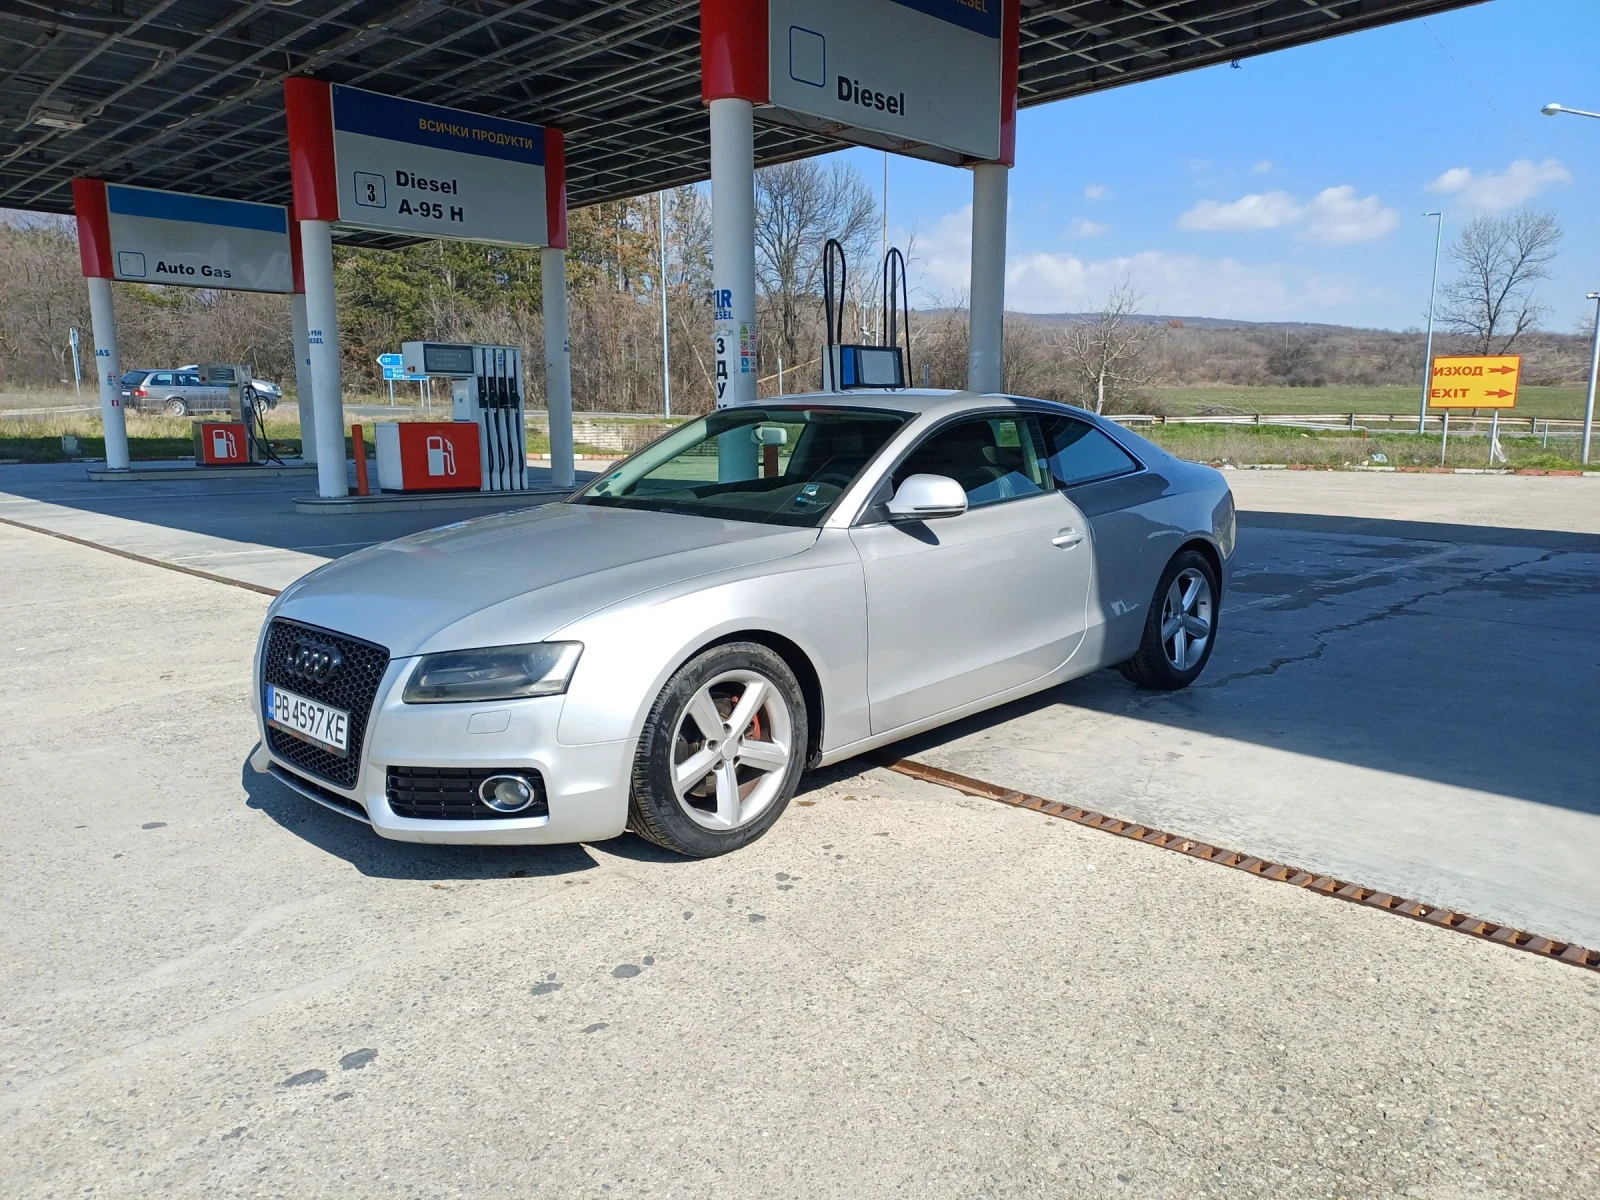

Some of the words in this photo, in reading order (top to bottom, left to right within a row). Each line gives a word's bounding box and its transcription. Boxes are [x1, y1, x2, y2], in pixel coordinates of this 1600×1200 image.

[837, 75, 905, 116] Diesel
[419, 118, 469, 138] ВСИЧКИ
[472, 128, 533, 149] ПРОДУКТИ
[396, 170, 457, 194] Diesel
[366, 184, 376, 202] 3
[398, 199, 443, 219] A-95
[155, 261, 195, 275] Auto
[201, 265, 231, 278] Gas
[1433, 366, 1484, 377] ИЗХОД
[1431, 388, 1470, 398] EXIT
[275, 692, 290, 722] PB
[292, 700, 325, 734] 4597
[325, 711, 345, 744] KE
